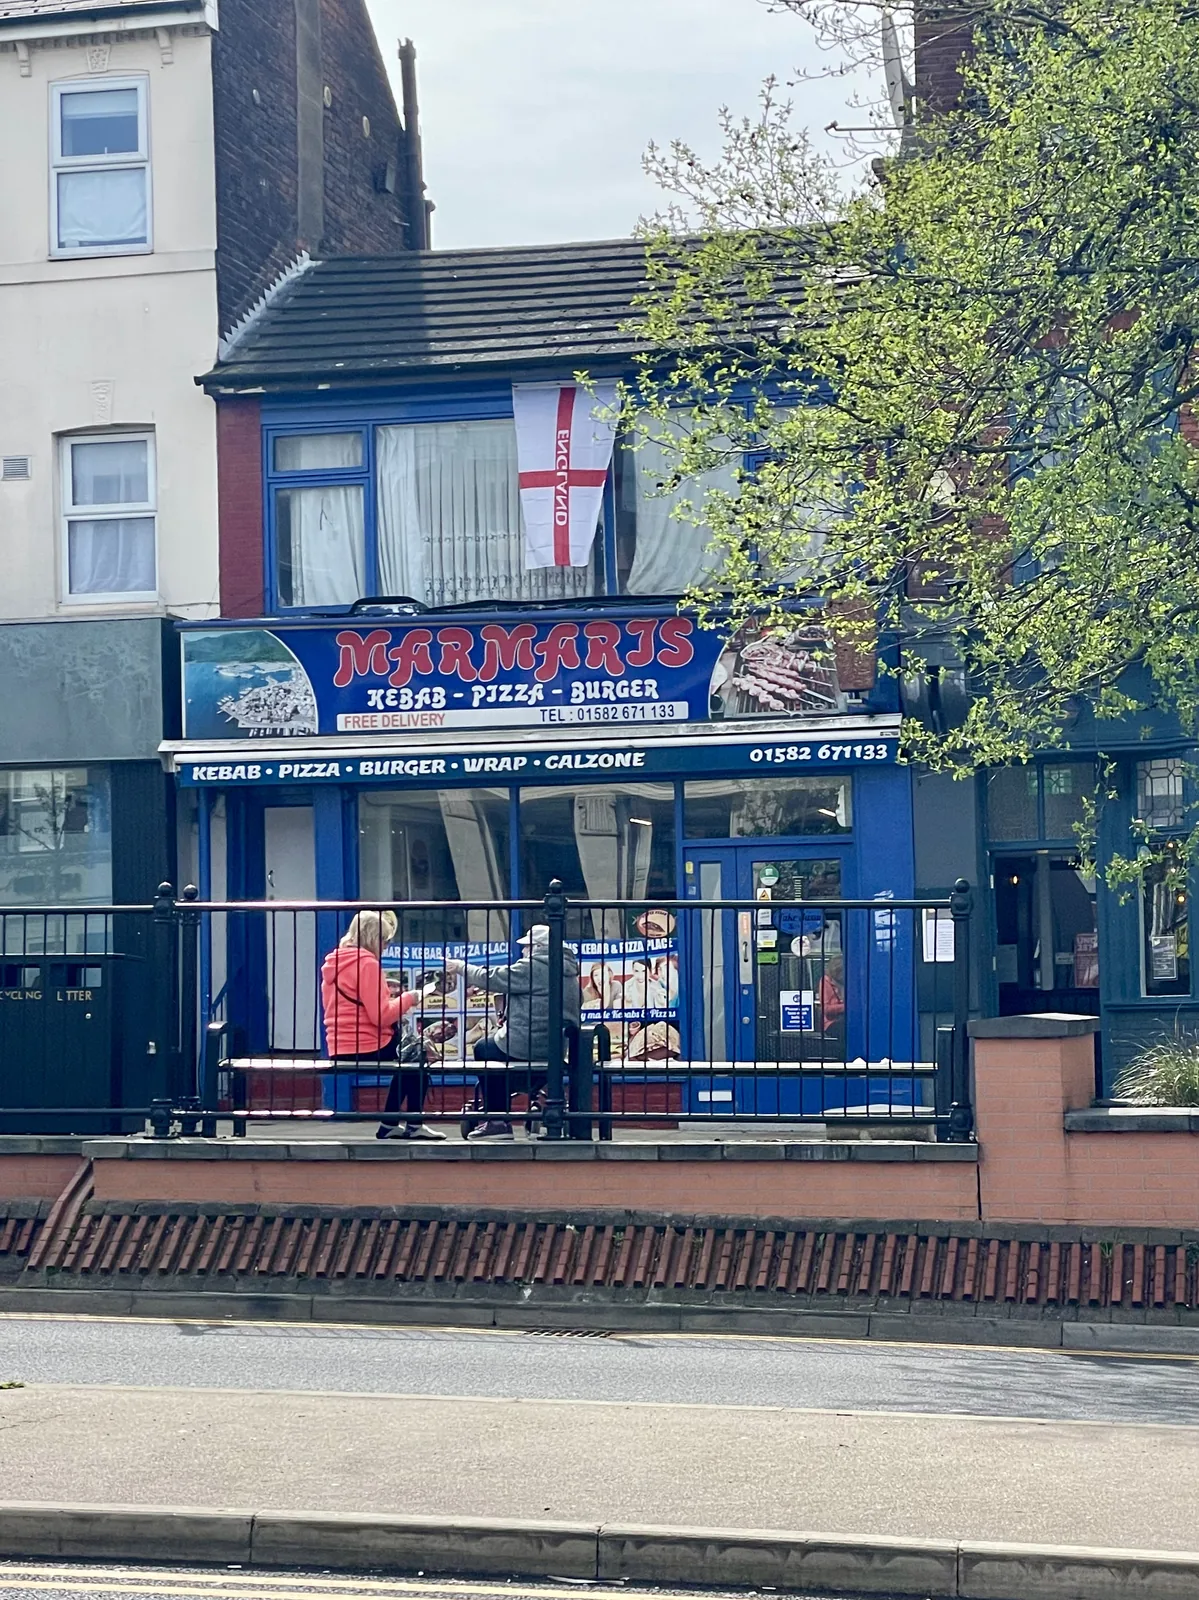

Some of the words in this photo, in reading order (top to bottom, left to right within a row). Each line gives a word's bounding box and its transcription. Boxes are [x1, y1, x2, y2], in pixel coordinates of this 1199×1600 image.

[333, 617, 694, 687] MARMARIS
[367, 687, 447, 710] KEBAB
[472, 683, 545, 707] PIZZA
[570, 679, 659, 704] BURGER
[344, 715, 379, 729] FREE
[381, 712, 446, 728] DELIVERY
[577, 706, 619, 721] 01582
[622, 705, 646, 720] 671
[651, 704, 675, 719] 133
[749, 746, 812, 763] 01582
[817, 744, 888, 761] 671133
[192, 765, 262, 781] KEBAB
[279, 762, 340, 779] PIZZA
[359, 759, 446, 776] BURGER
[463, 756, 527, 773] WRAP
[545, 752, 646, 770] CALZONE
[581, 942, 609, 955] KEBAB
[611, 943, 618, 954] &
[57, 990, 92, 1001] LTTER
